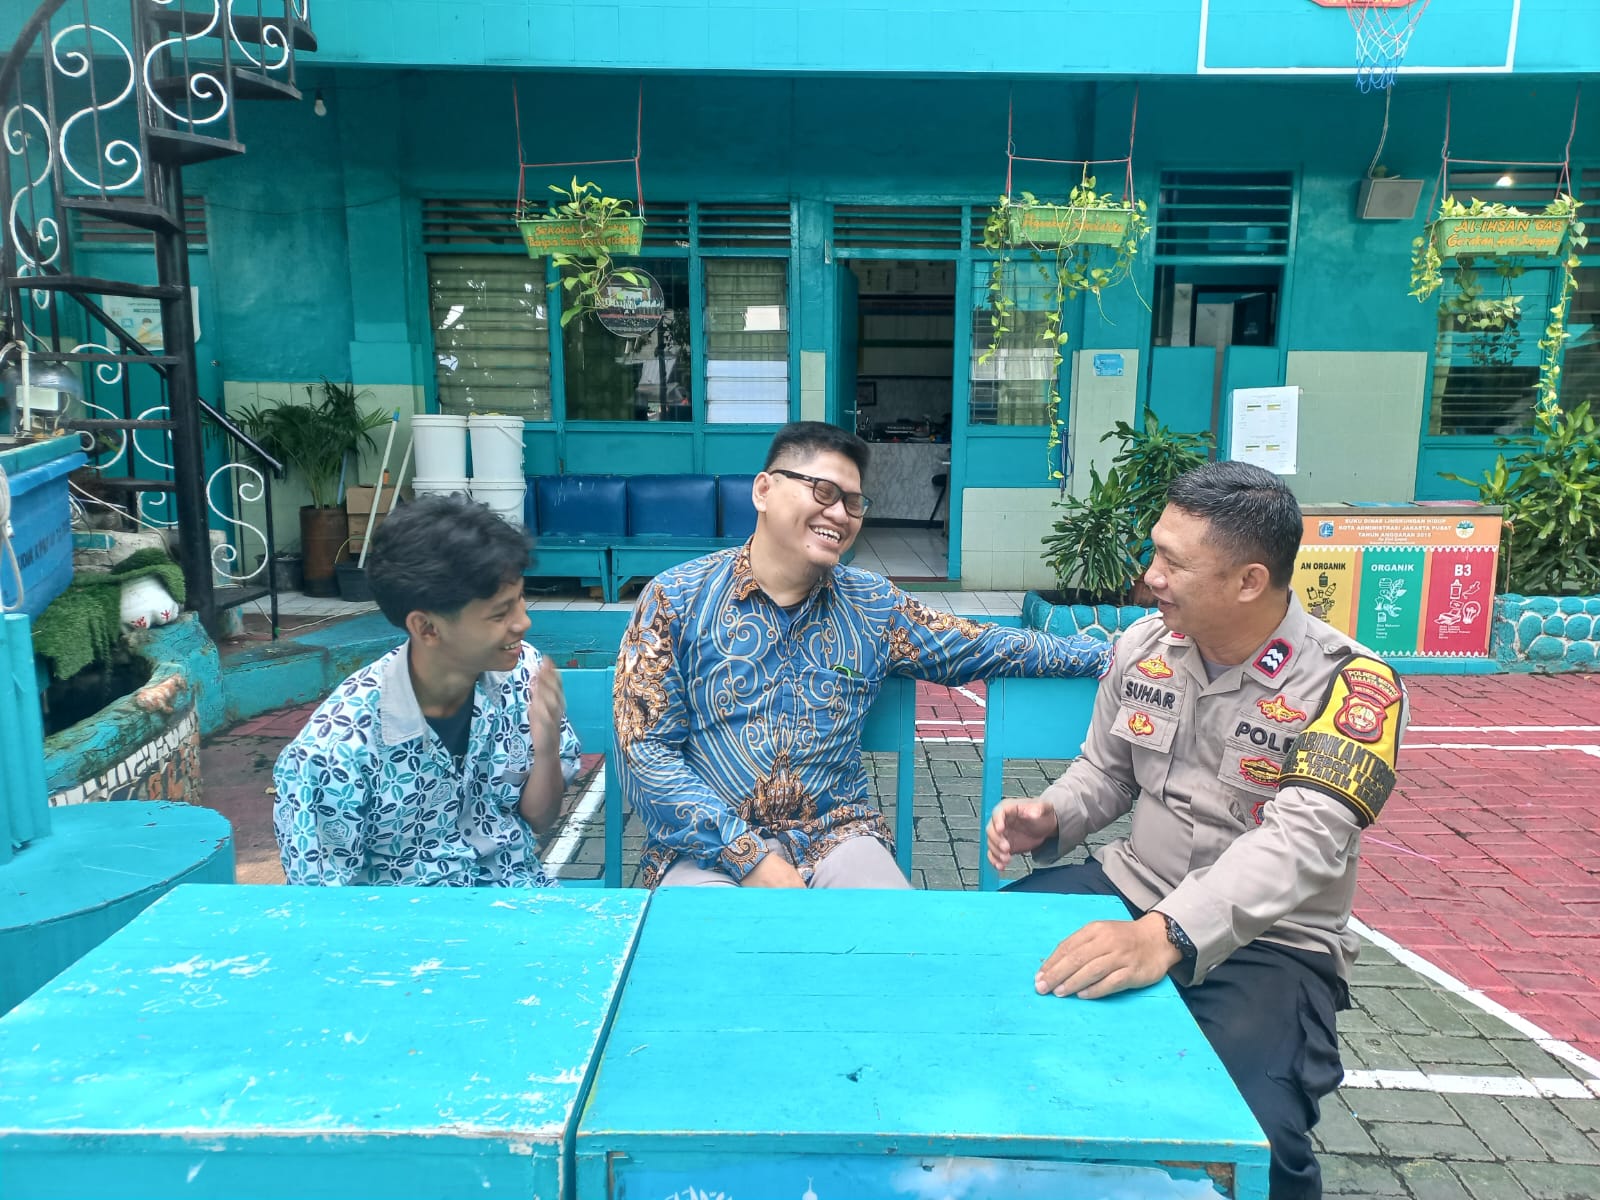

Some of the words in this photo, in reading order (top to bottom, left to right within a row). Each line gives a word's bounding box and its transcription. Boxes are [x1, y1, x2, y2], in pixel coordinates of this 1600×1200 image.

[1314, 562, 1346, 570] ORGANIK
[1370, 563, 1415, 572] ORGANIK
[1454, 564, 1472, 577] B3
[1125, 681, 1176, 709] SUHAR
